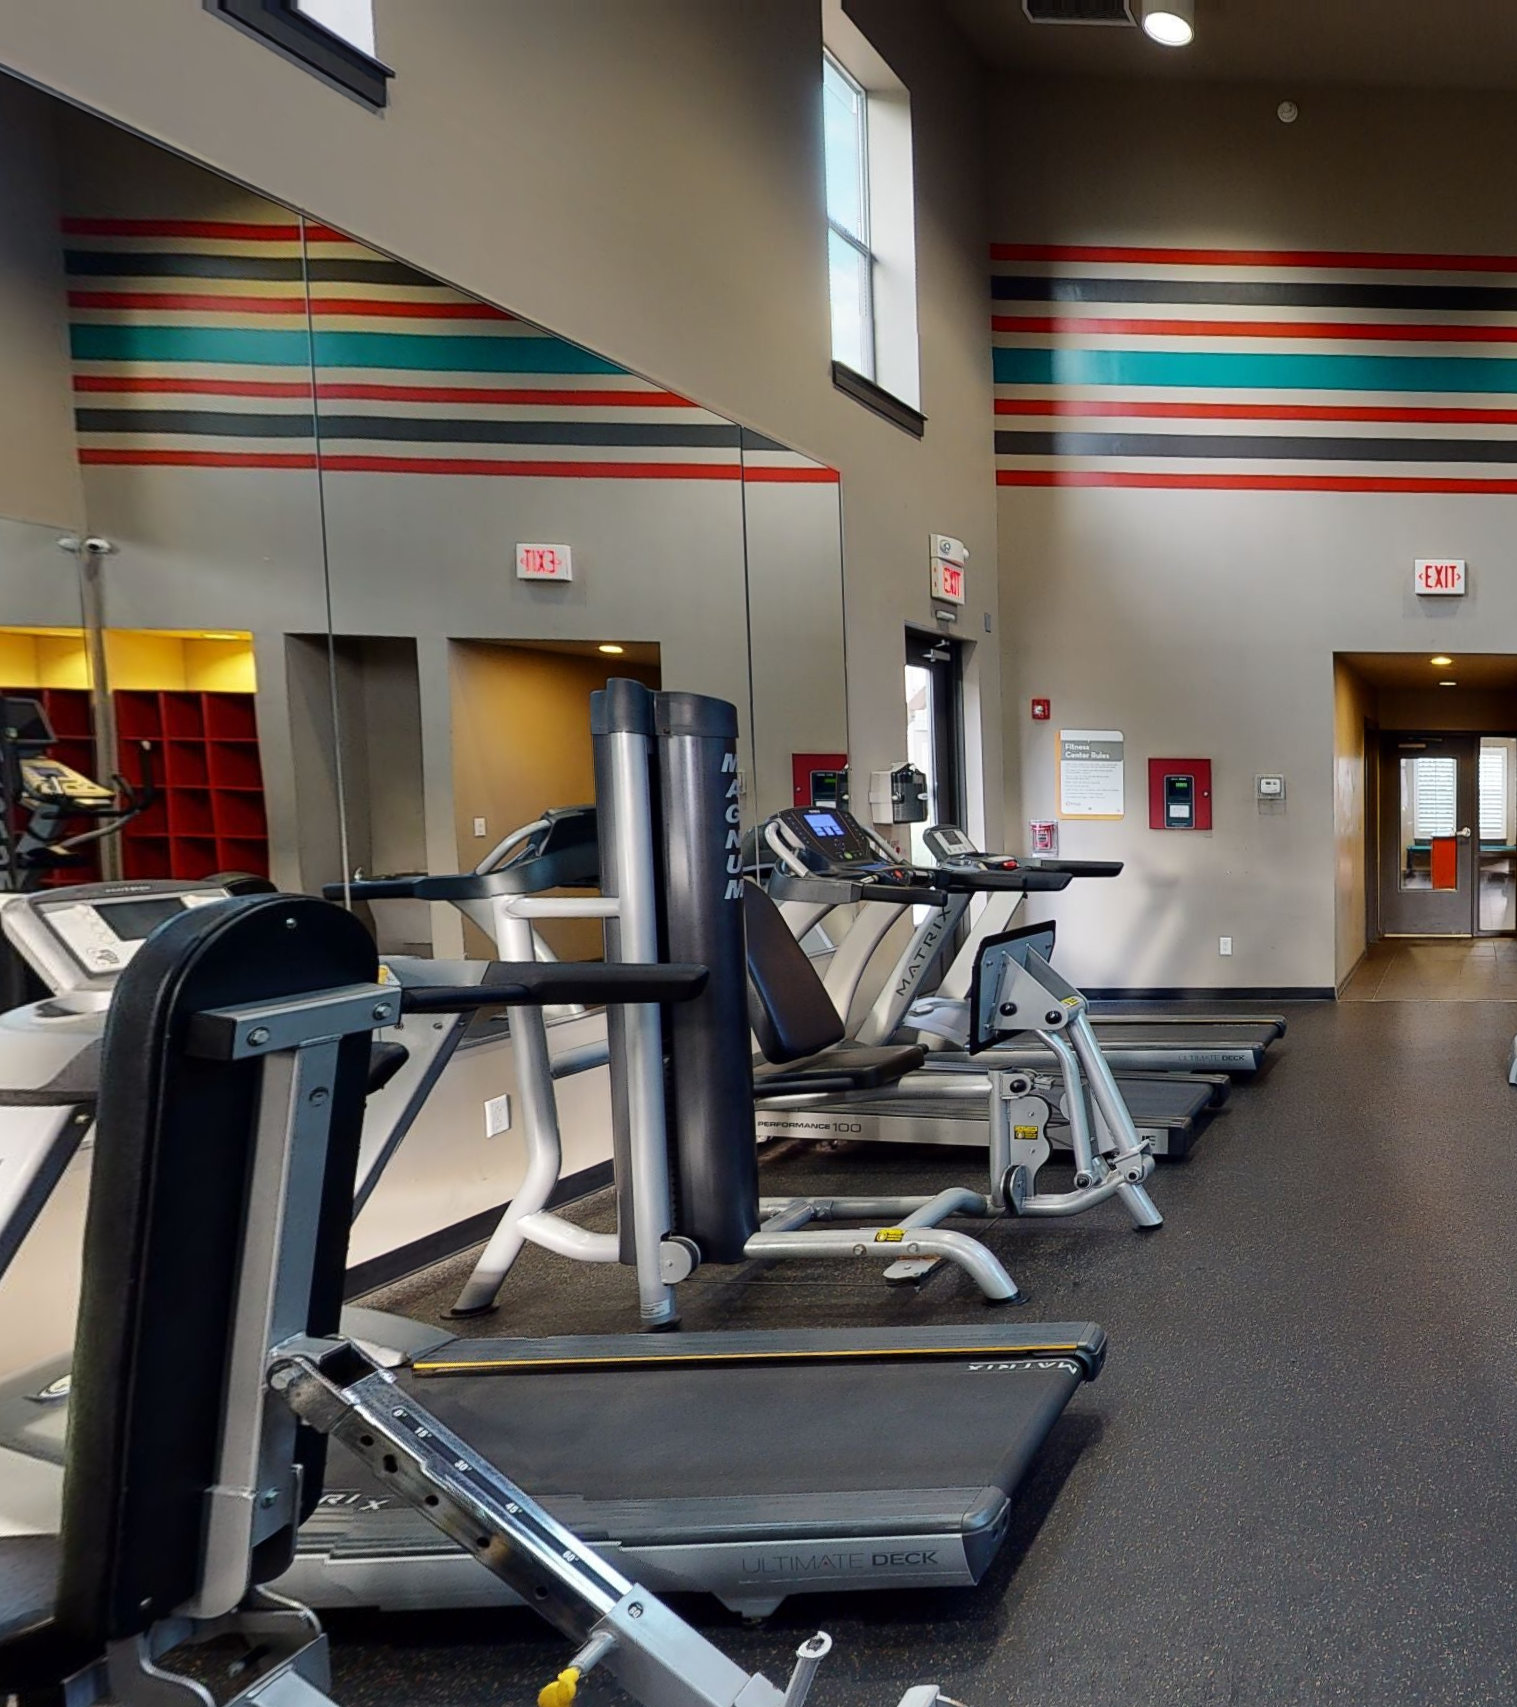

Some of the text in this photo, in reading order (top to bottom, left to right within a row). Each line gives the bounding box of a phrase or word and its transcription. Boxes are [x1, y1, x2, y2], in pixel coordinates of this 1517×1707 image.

[943, 567, 961, 597] EXIT
[1425, 565, 1457, 588] EXIT
[1065, 743, 1090, 751] Fitness
[1065, 751, 1110, 760] Center Rules
[895, 906, 952, 997] MATRIX
[757, 1120, 862, 1133] PERFORMANCE 100
[741, 1551, 938, 1574] ULTIMATE DECK
